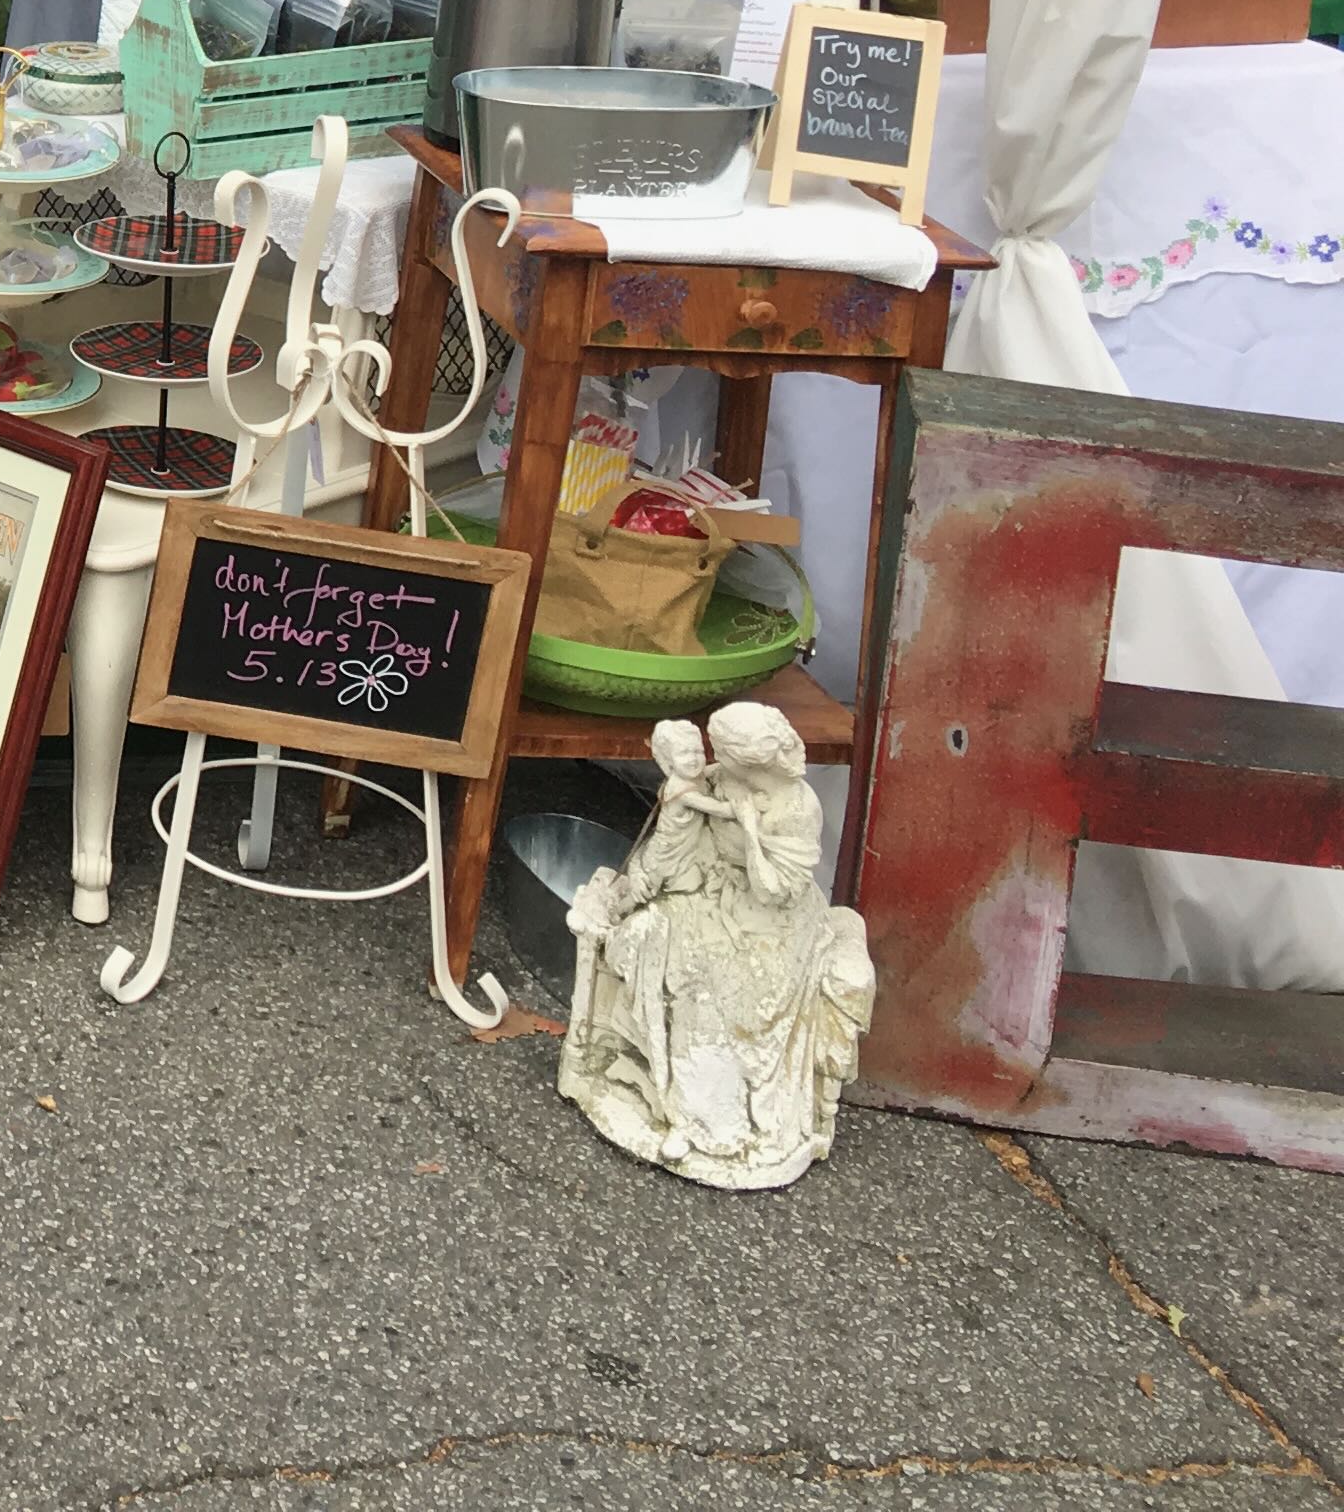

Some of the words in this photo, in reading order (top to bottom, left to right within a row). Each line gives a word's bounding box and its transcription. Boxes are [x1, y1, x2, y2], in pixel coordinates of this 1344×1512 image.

[814, 34, 861, 68] Try
[868, 41, 911, 67] me!
[820, 66, 868, 87] Our
[812, 88, 899, 114] special
[806, 109, 873, 141] brand
[878, 118, 908, 145] tea
[215, 554, 290, 597] don't
[283, 563, 436, 628] forget
[221, 600, 351, 652] Mothers
[226, 651, 337, 686] 5.13
